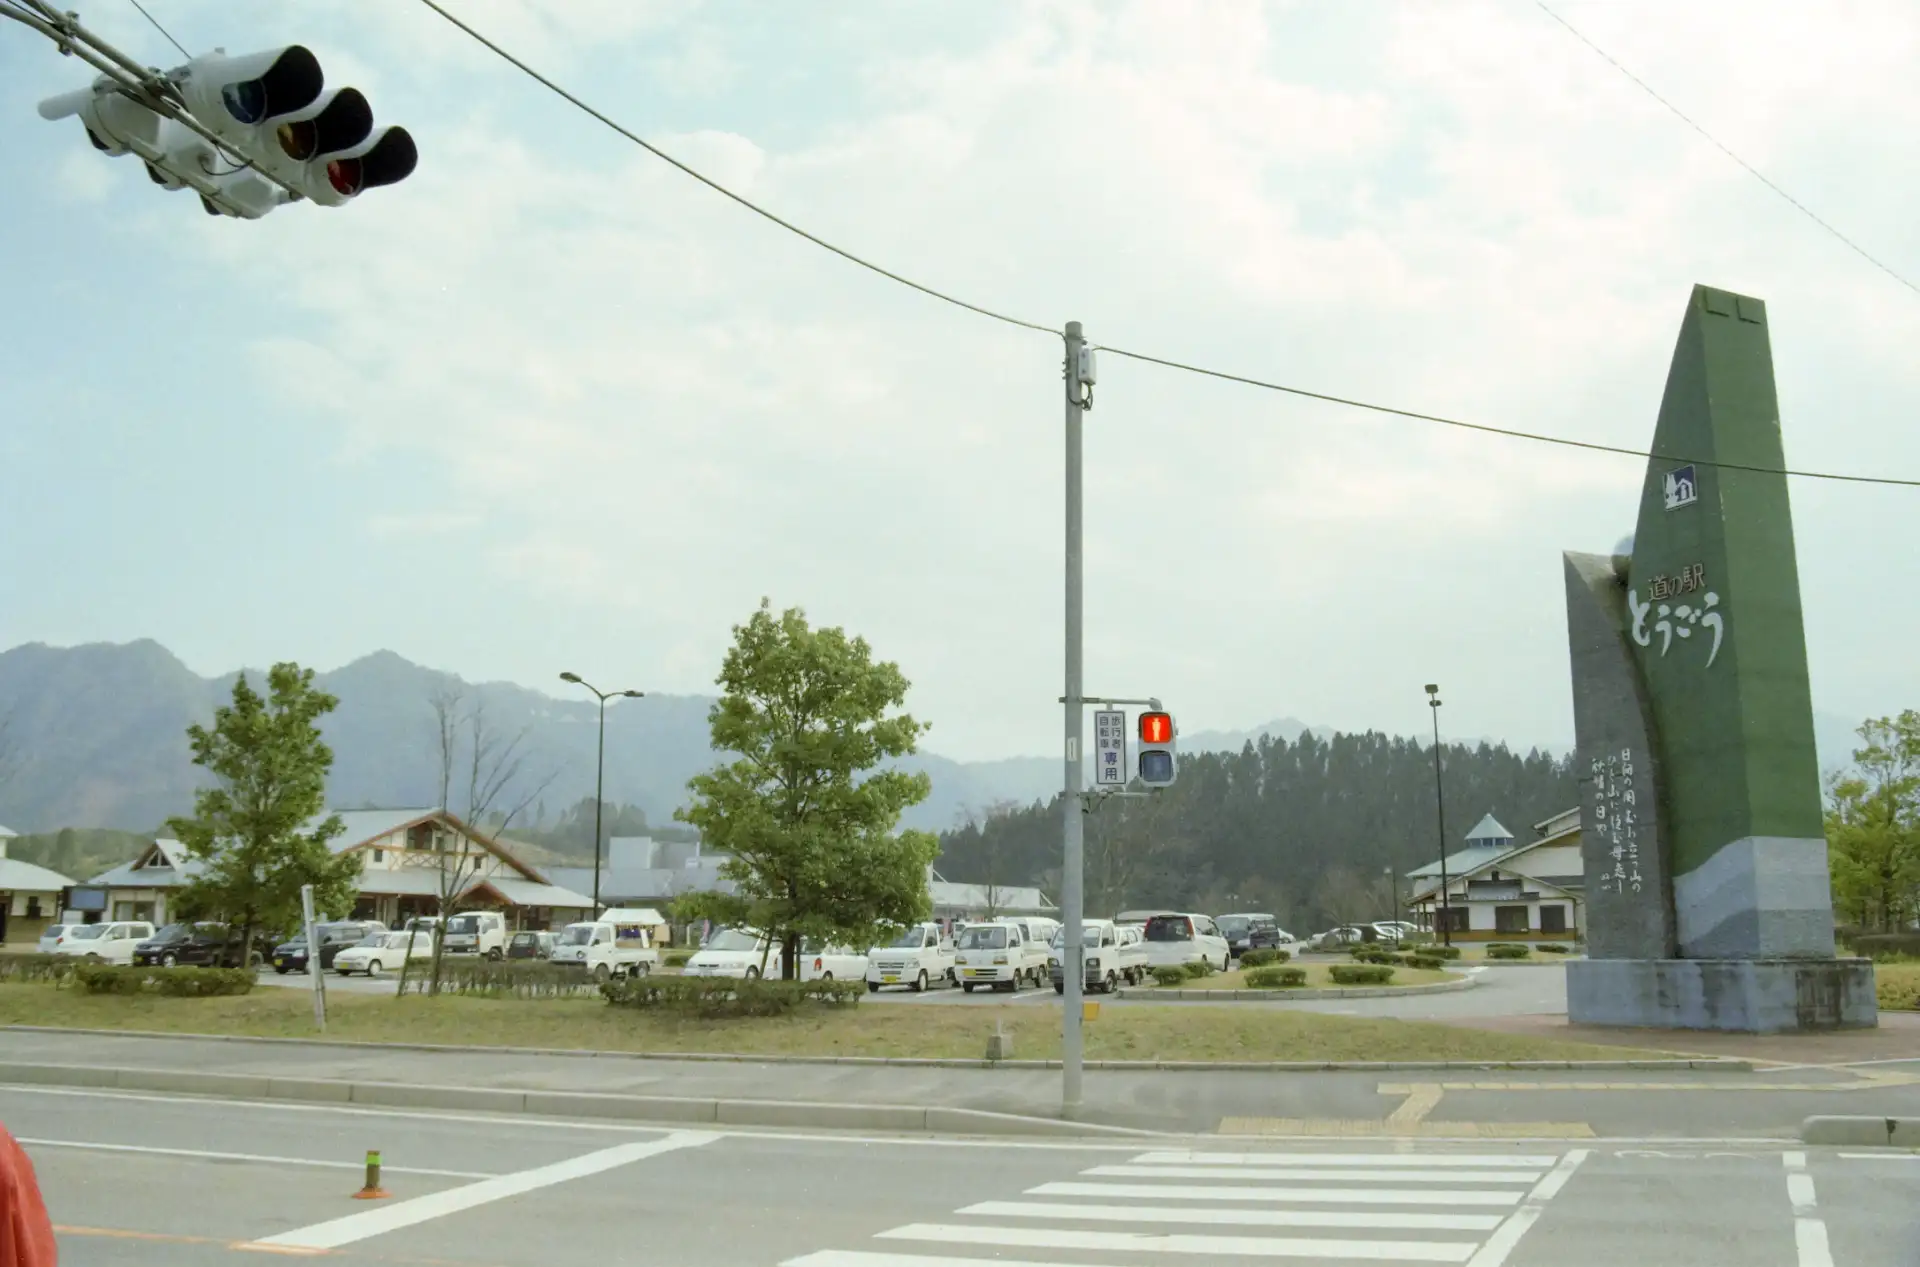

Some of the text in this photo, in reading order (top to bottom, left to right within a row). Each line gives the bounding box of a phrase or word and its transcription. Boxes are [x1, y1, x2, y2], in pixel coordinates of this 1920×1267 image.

[1648, 563, 1706, 601] 道の駅
[1628, 590, 1724, 669] とうごう
[1104, 752, 1117, 780] 専用
